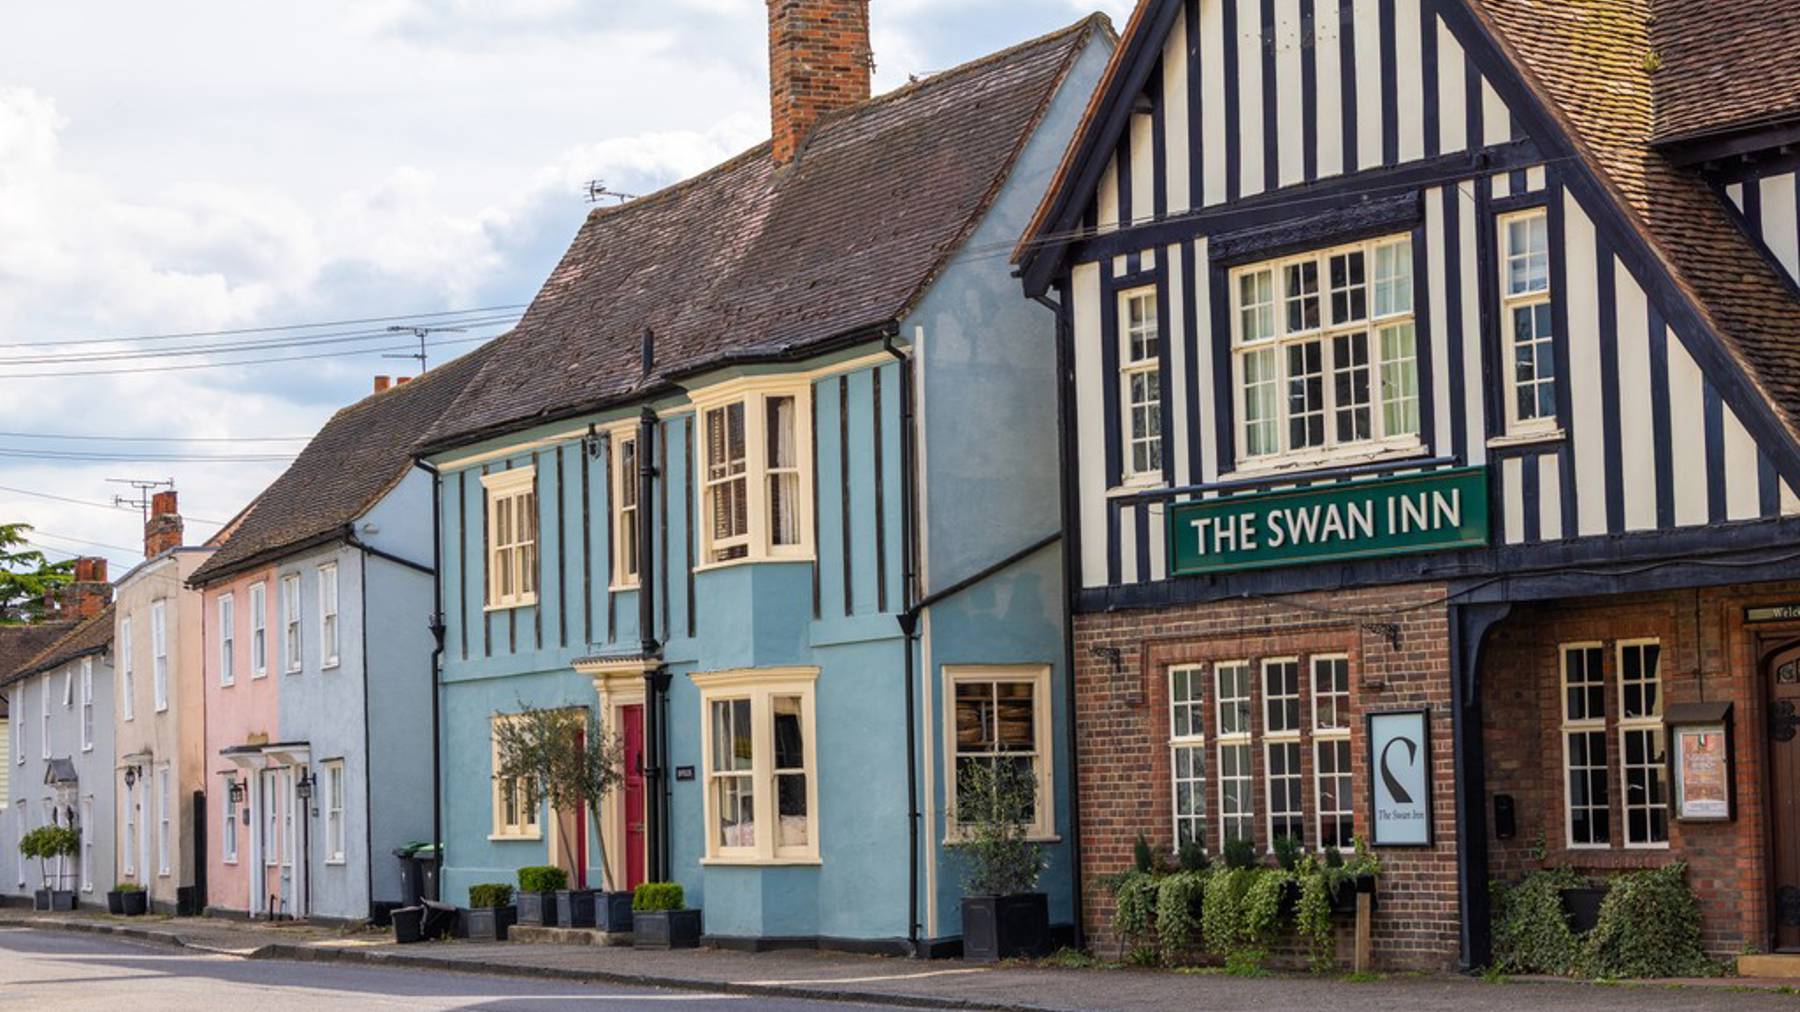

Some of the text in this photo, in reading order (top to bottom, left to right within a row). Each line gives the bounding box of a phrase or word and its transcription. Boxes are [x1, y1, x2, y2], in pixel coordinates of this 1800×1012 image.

[1190, 488, 1460, 555] THE SWAN INN
[1379, 809, 1424, 821] The Swan Inn
